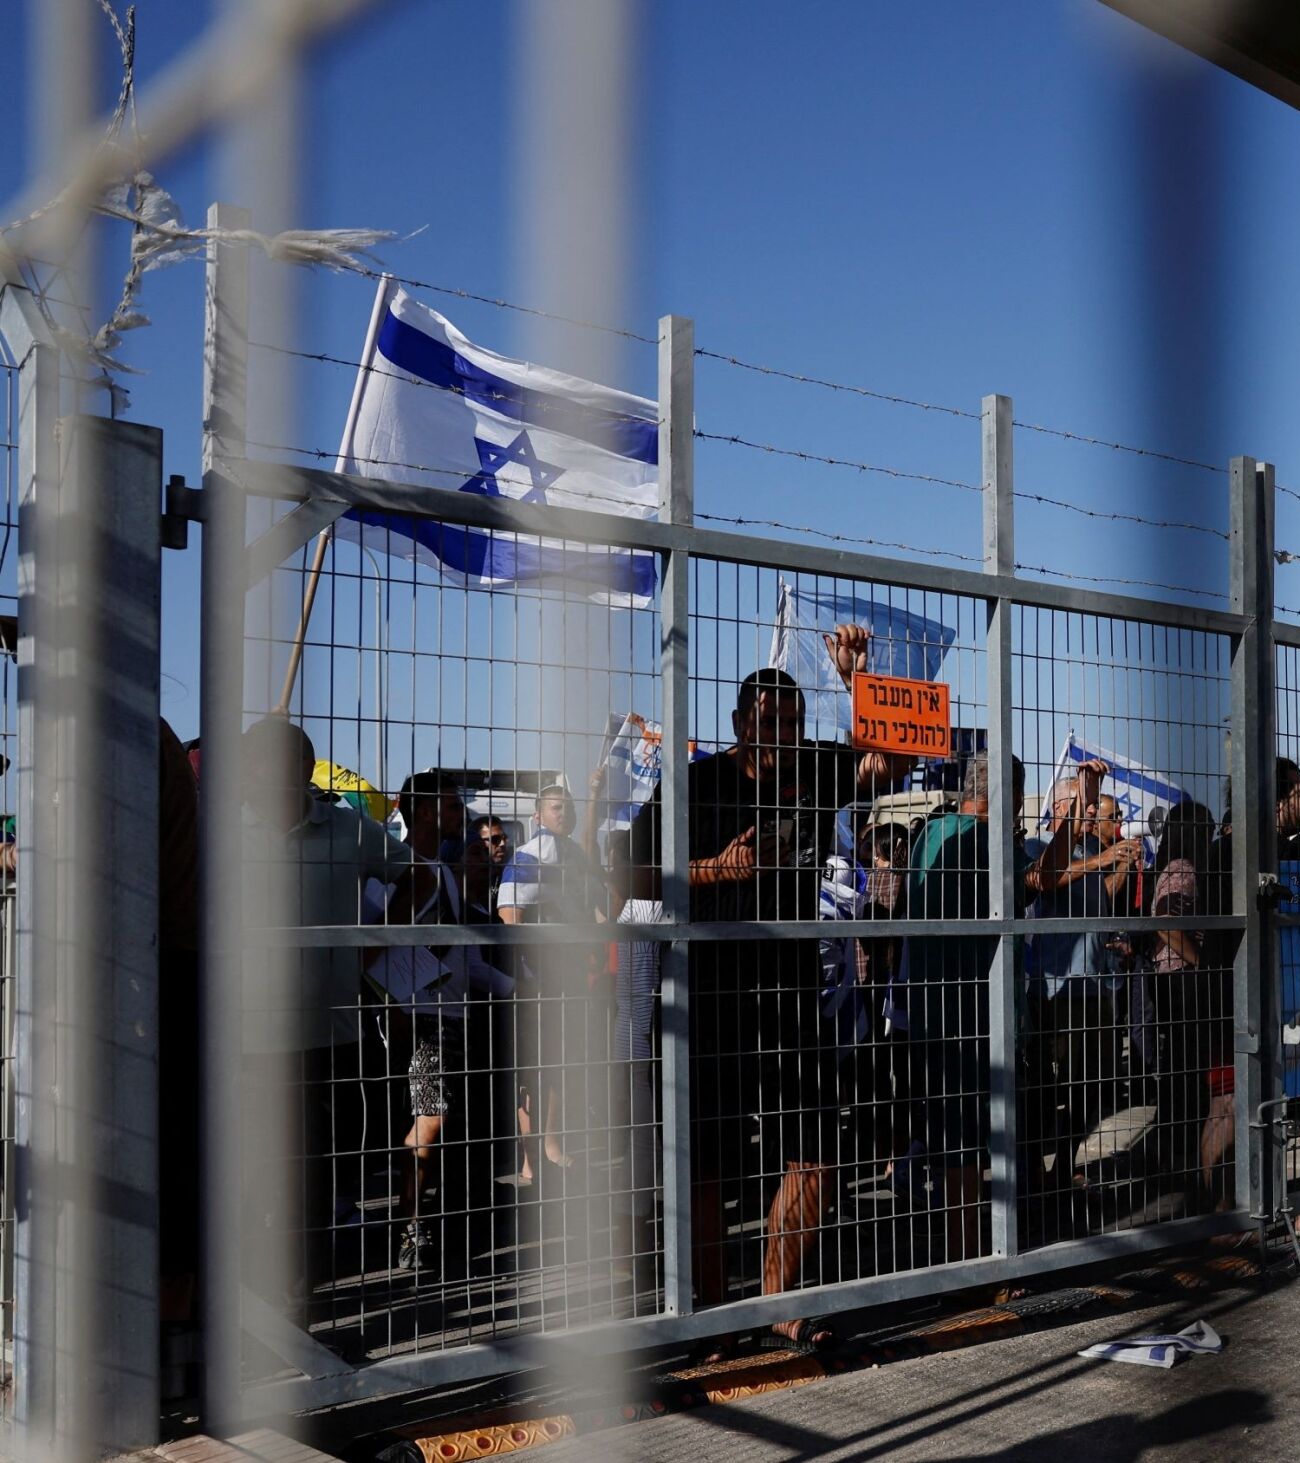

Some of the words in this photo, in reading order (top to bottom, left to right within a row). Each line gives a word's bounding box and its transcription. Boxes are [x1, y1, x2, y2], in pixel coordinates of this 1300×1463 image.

[868, 683, 912, 709] מעבר
[917, 689, 940, 715] אין
[858, 715, 888, 741] רגל
[892, 720, 946, 747] להולכי
